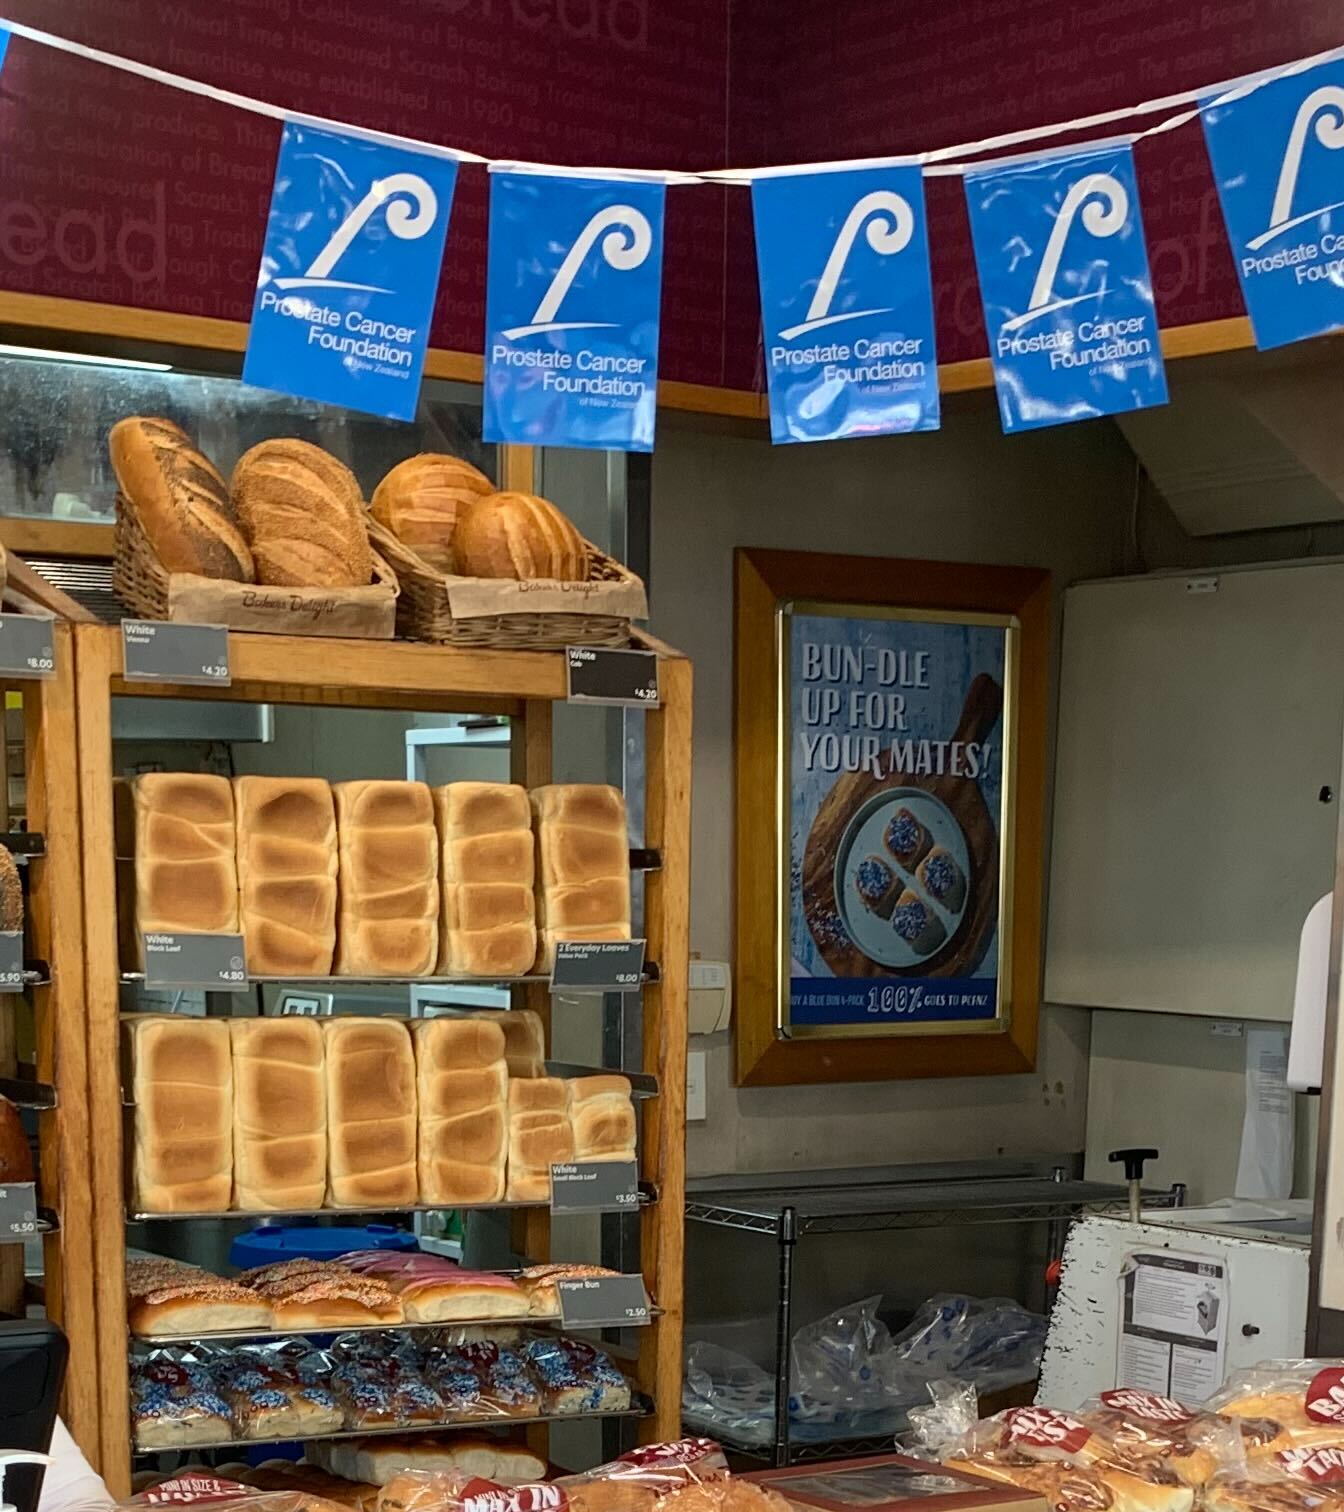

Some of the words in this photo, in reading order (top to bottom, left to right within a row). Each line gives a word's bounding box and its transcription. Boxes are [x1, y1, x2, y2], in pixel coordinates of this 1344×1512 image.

[1242, 244, 1318, 278] Prostate
[998, 331, 1074, 358] Prostate
[1078, 315, 1145, 342] Cancer
[493, 345, 570, 370] Prostate
[575, 352, 646, 374] Cancer
[1051, 338, 1149, 370] Foundation
[543, 372, 646, 397] Foundation
[125, 625, 156, 636] White
[570, 650, 596, 660] White
[202, 666, 228, 676] $4.20
[802, 643, 931, 690] BUN-DLE
[634, 688, 656, 698] $4.20
[802, 688, 840, 726] UP
[849, 692, 908, 732] FOR
[800, 732, 886, 782] YOUR
[890, 742, 992, 779] MATES!
[146, 935, 174, 944] White
[552, 1165, 578, 1174] White
[10, 1222, 34, 1232] $5.50
[626, 1308, 646, 1316] $2.50
